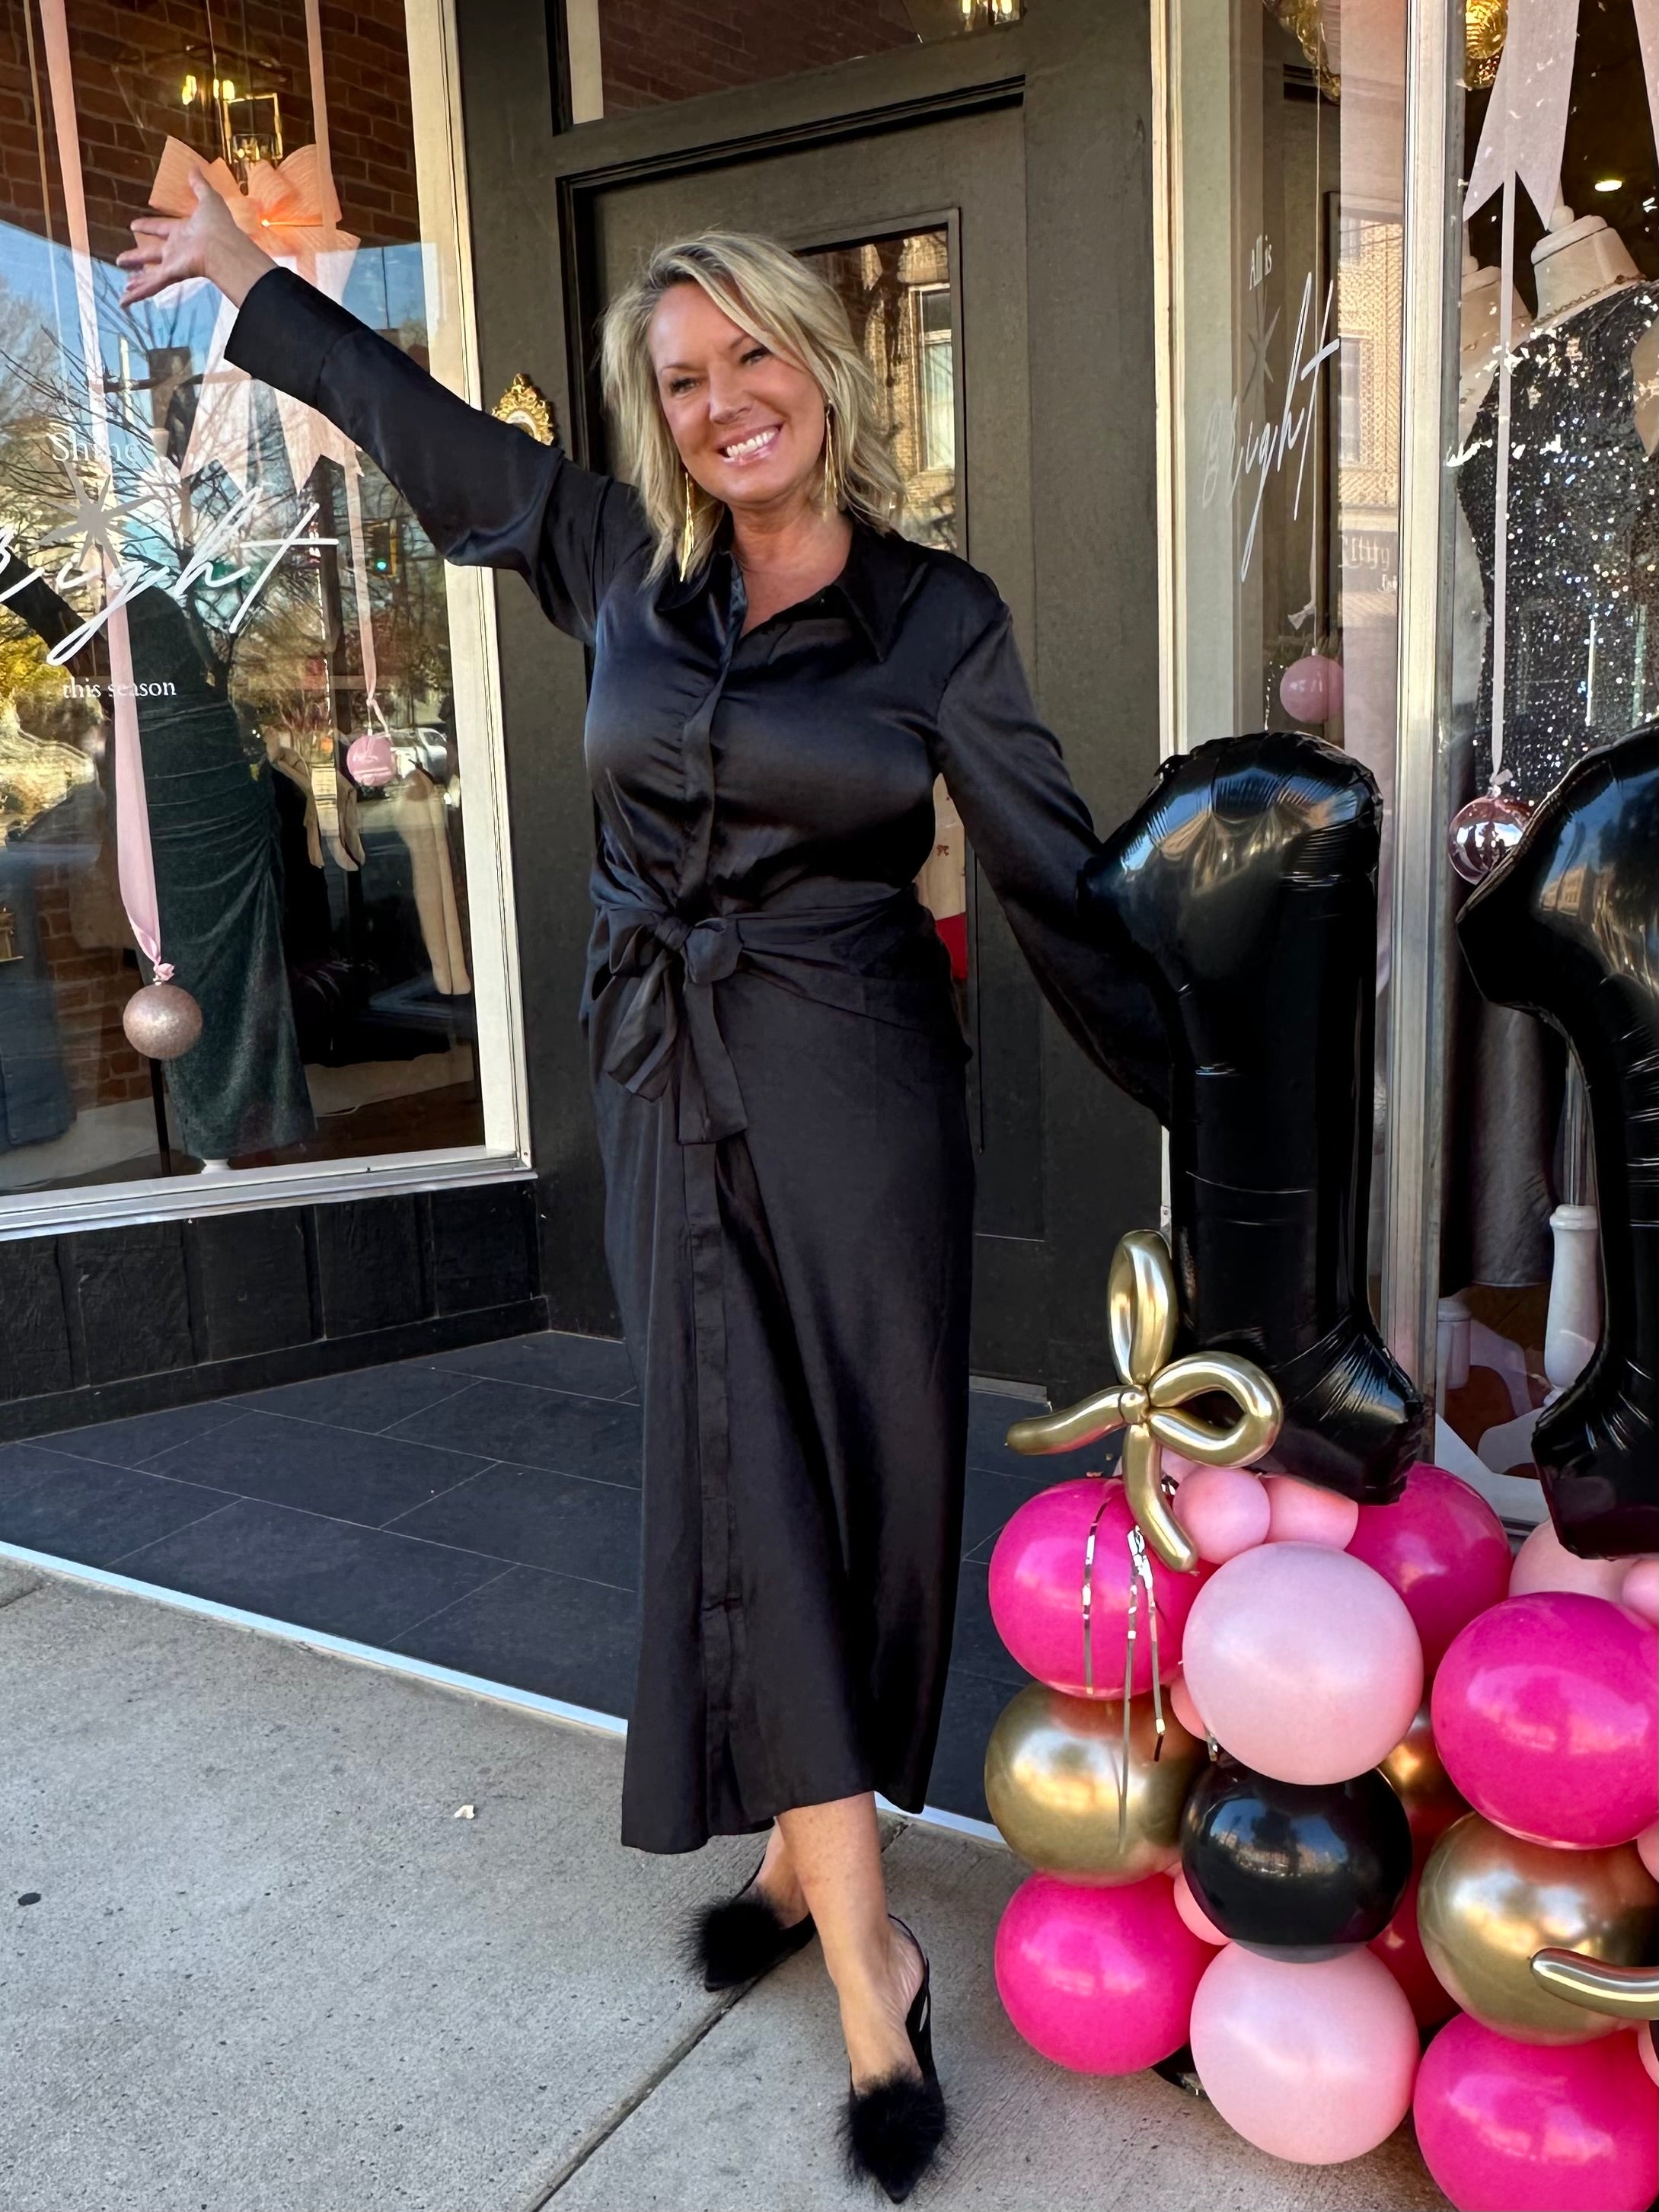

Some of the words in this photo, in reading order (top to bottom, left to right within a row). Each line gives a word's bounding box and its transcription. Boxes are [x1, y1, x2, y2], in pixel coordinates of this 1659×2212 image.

[47, 431, 136, 461] Shne
[0, 486, 340, 666] right
[62, 675, 102, 699] this
[107, 681, 177, 697] season
